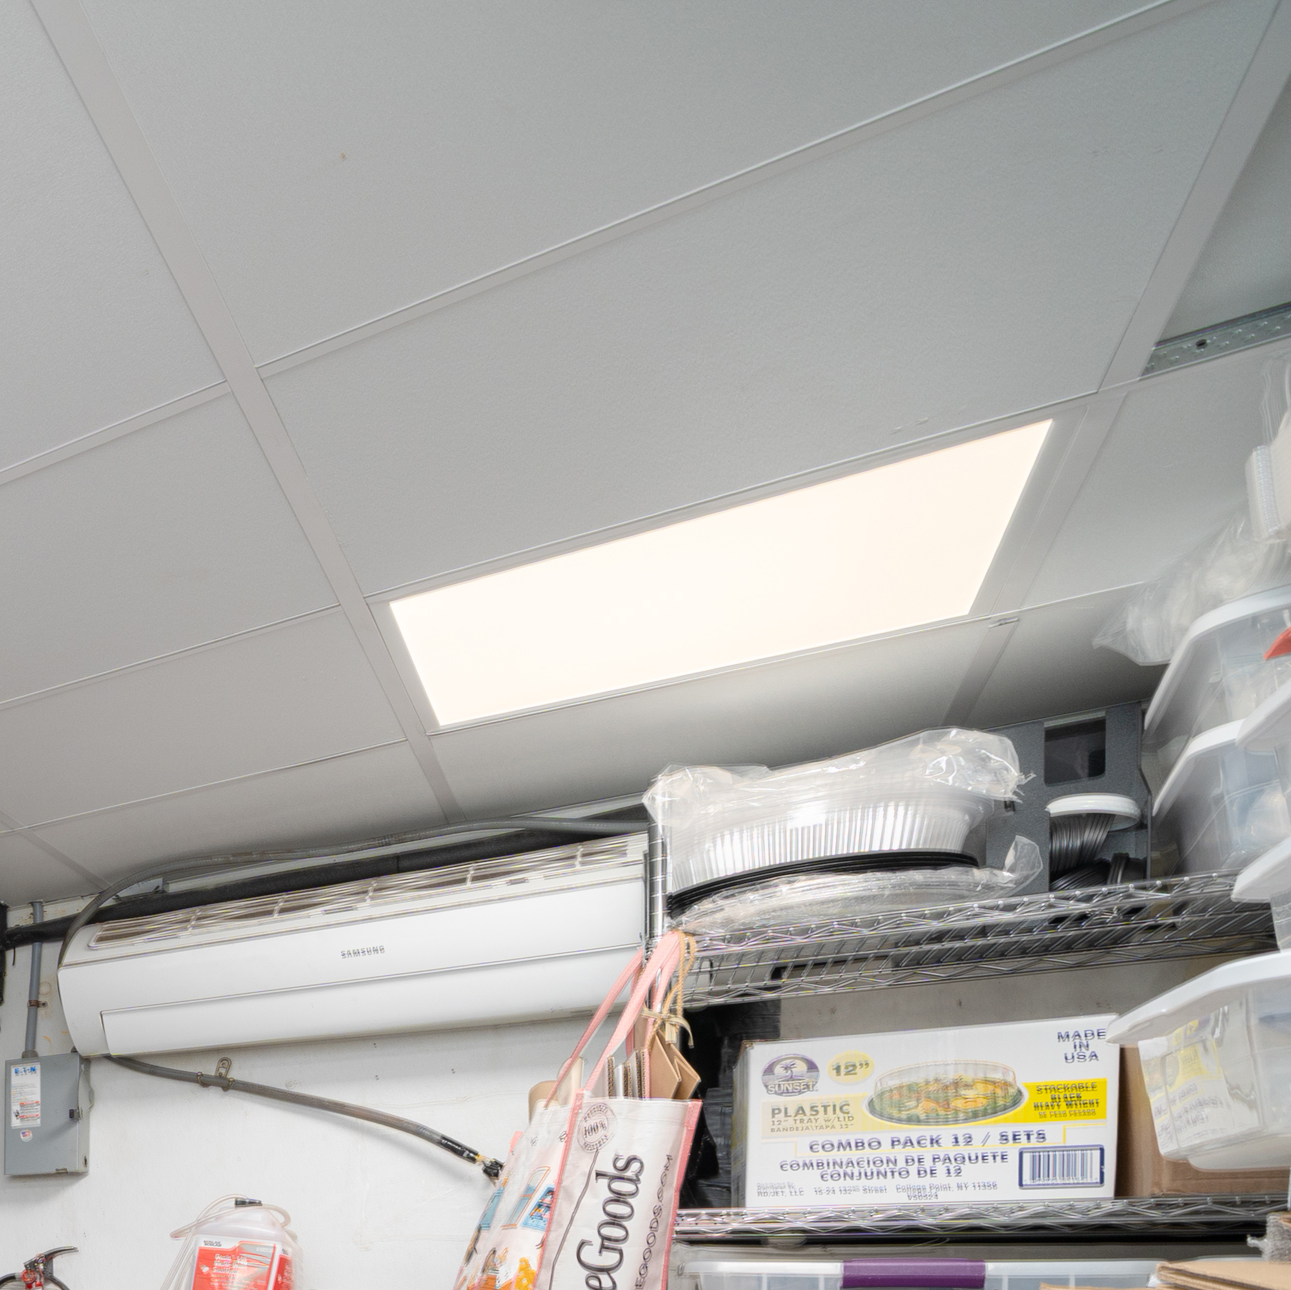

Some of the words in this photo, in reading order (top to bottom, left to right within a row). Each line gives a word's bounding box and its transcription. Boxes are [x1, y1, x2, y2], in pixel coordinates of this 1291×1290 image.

[340, 945, 385, 959] SAMSUNG
[1057, 1028, 1106, 1043] MADE
[1073, 1041, 1090, 1052] IN
[1064, 1051, 1099, 1063] USA
[767, 1083, 815, 1095] SUNSET
[1036, 1082, 1098, 1095] STACKABLE
[1050, 1093, 1082, 1103] BLACK
[771, 1101, 851, 1118] PLASTIC
[1033, 1101, 1062, 1111] HEAVY
[1065, 1098, 1100, 1109] WEIGHT
[1049, 1110, 1067, 1118] PESO
[1069, 1108, 1097, 1117] PESADO
[793, 1116, 819, 1125] TRAY
[808, 1138, 883, 1153] COMBO
[890, 1134, 943, 1150] PACK
[951, 1133, 973, 1147] 12
[998, 1129, 1047, 1145] SETS
[779, 1155, 898, 1172] COMBINACION
[904, 1154, 926, 1167] DE
[932, 1151, 1009, 1165] PAQUETE
[820, 1167, 910, 1182] CONJUNTO
[917, 1166, 938, 1178] DE
[945, 1165, 962, 1177] 12
[789, 1188, 804, 1196] LLC
[862, 1185, 888, 1194] Street
[956, 1182, 969, 1191] NY
